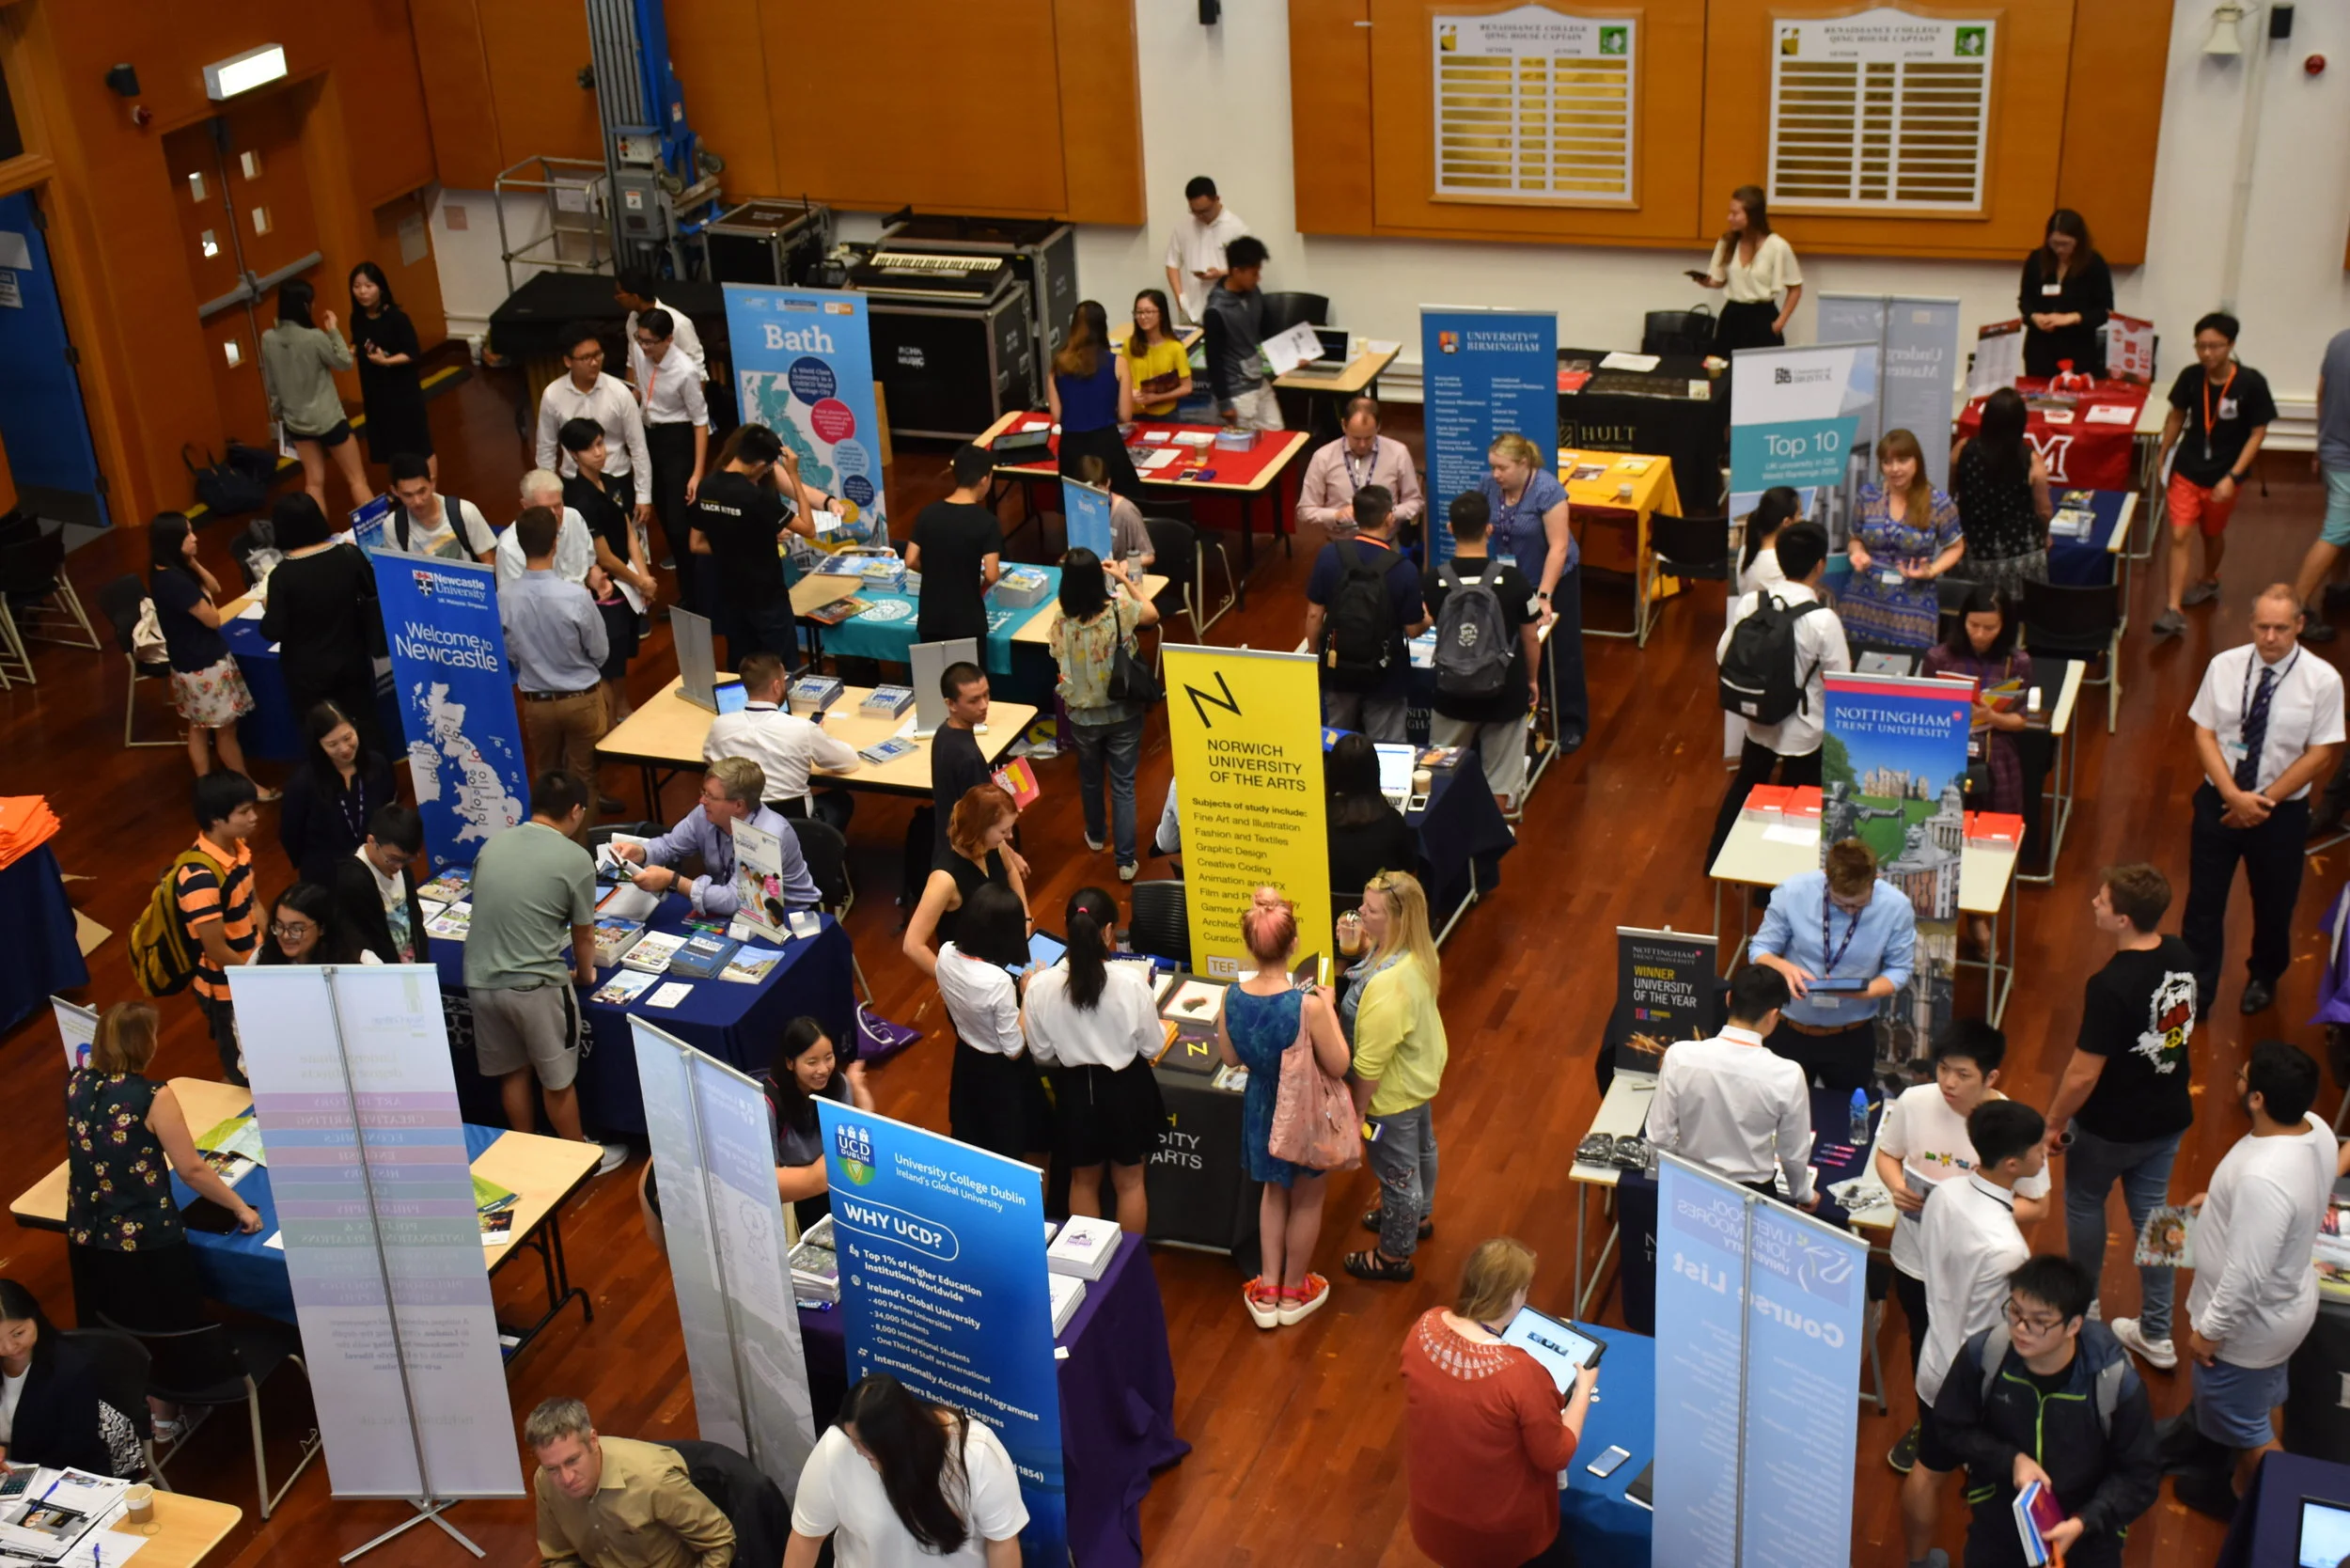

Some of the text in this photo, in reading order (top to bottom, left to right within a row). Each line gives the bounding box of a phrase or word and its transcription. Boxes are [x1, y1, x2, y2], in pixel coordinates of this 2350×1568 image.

[763, 323, 836, 354] Bath
[1466, 331, 1528, 342] UNIVERSITY
[1466, 342, 1540, 353] BIRMINGHAM
[1581, 425, 1637, 442] HULT
[1763, 430, 1840, 460] Top 10
[433, 572, 486, 589] Newcastle
[435, 584, 486, 602] University
[405, 621, 494, 651] Welcome to
[395, 634, 499, 672] Newcastle
[1183, 670, 1243, 729] N
[1835, 706, 1951, 729] NOTTINGHAM
[1835, 719, 1951, 739] TRENT UNIVERSITY
[1207, 739, 1283, 758] NORWICH
[1209, 756, 1303, 776] UNIVERSITY
[1210, 771, 1307, 792] OF THE ARTS
[1192, 797, 1231, 810] Subjects
[1245, 804, 1269, 815] study
[1271, 805, 1308, 817] include:
[1194, 812, 1300, 832] Fine Art and Illustration
[1195, 827, 1289, 846] Fashion and Textiles
[1196, 842, 1267, 859] Graphic Design
[1198, 857, 1272, 875] Creative Coding
[1198, 872, 1286, 890] Animation and VFX
[1199, 887, 1239, 900] Film and
[1200, 902, 1233, 914] Games
[1202, 917, 1243, 930] Architec
[1203, 932, 1243, 944] Curation
[1633, 946, 1696, 960] NOTTINGHAM
[1211, 960, 1235, 973] TEF
[1634, 965, 1675, 980] WINNER
[1634, 978, 1693, 995] UNIVERSITY
[1634, 989, 1698, 1009] OF THE YEAR
[838, 1135, 870, 1156] UCD
[840, 1148, 870, 1163] DUBLIN
[1150, 1148, 1202, 1169] ARTS
[894, 1152, 1026, 1206] University College Dublin
[896, 1167, 1003, 1213] Ireland's Global University
[843, 1202, 943, 1248] WHY UCD?
[863, 1248, 982, 1297] Top 1% of Higher Education
[865, 1262, 964, 1303] Institutions Worldwide
[867, 1282, 981, 1330] Ireland's Global University
[872, 1297, 952, 1332] 400 Partner Universities
[874, 1309, 930, 1336] 34,000 Students
[875, 1324, 970, 1363] 8,000 International Students
[877, 1336, 991, 1384] One Third of Staff are International
[874, 1353, 1039, 1421] Internationally Accredited Programmes
[901, 1382, 1004, 1428] nours Bachelor's Degrees
[1019, 1465, 1043, 1483] 1854)
